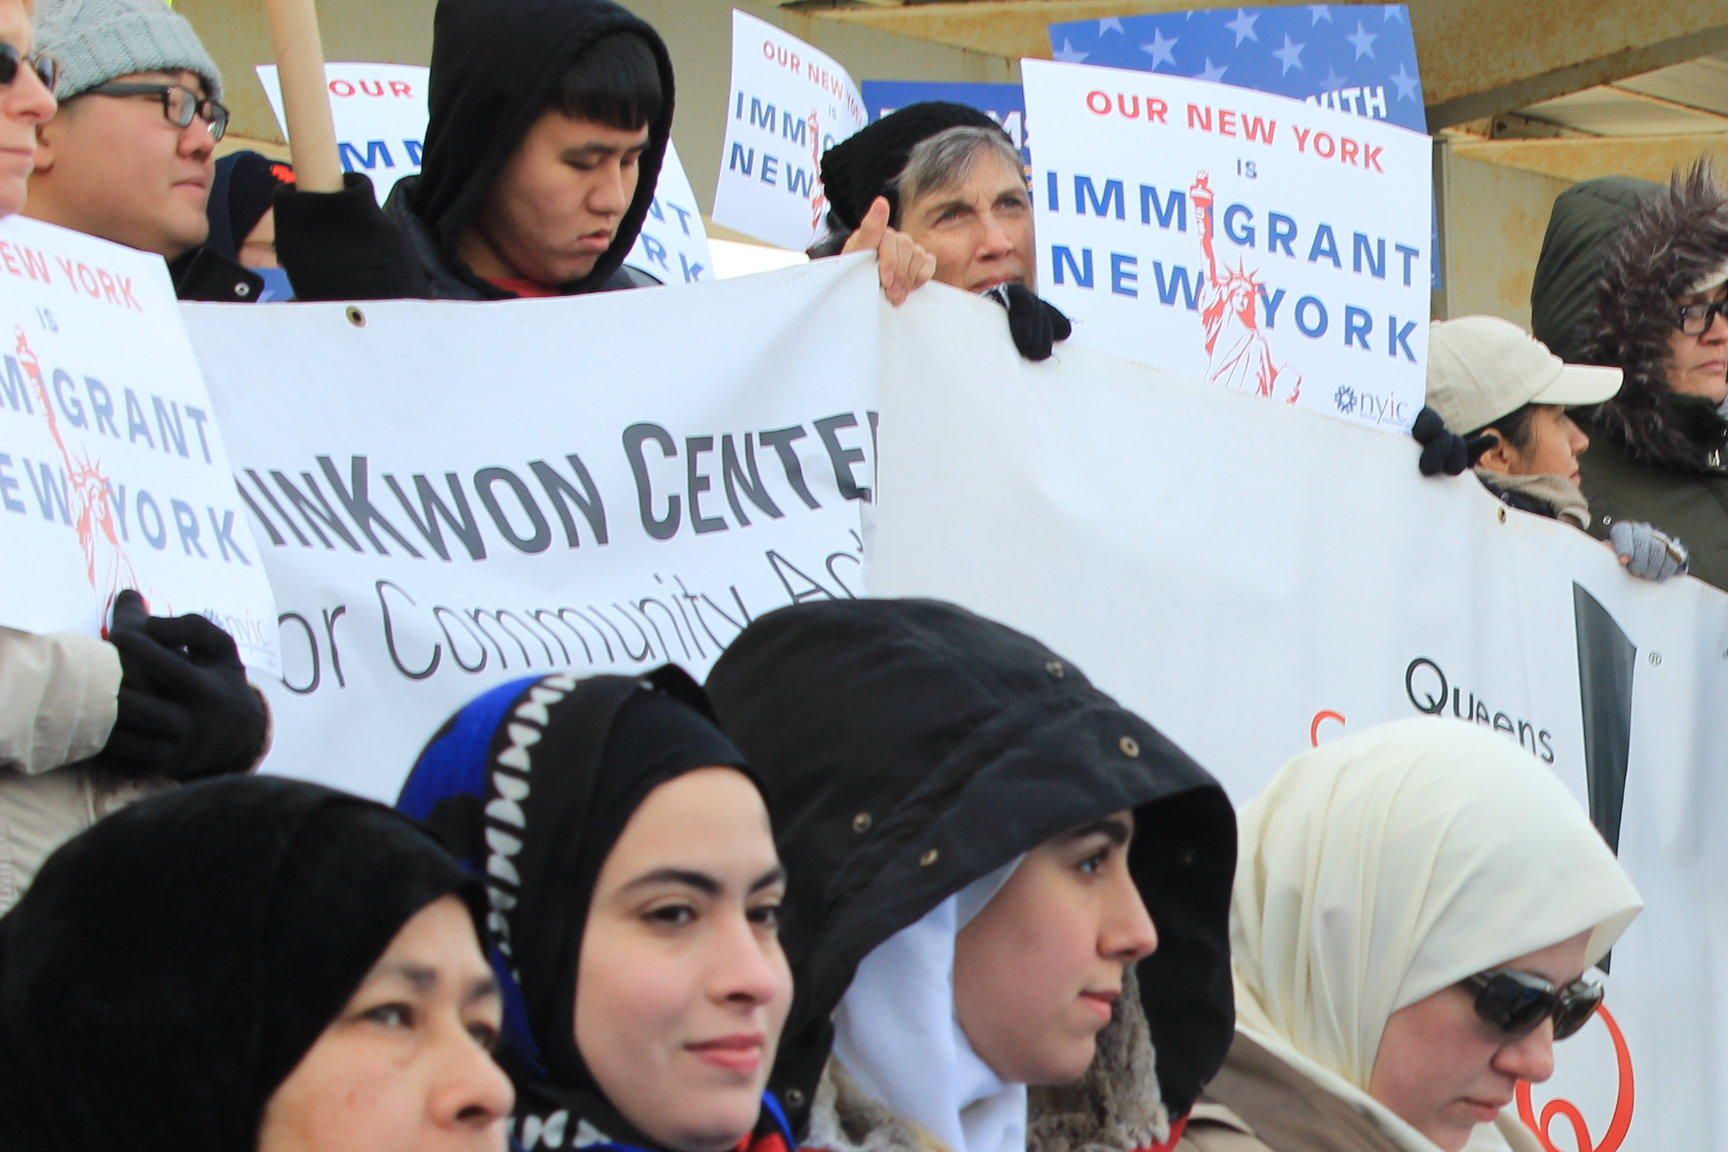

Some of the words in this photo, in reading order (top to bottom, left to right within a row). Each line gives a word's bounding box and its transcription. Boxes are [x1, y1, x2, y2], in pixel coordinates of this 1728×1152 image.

[328, 79, 414, 99] OUR
[761, 39, 801, 75] OUR
[807, 61, 844, 100] NEW
[1085, 89, 1168, 125] OUR
[1186, 102, 1277, 146] NEW
[1292, 124, 1385, 175] YORK
[1236, 157, 1259, 180] IS
[730, 140, 815, 201] NEW
[1045, 168, 1421, 289] IMMIGRANT
[0, 240, 51, 285] EW
[55, 254, 145, 315] YORK
[1050, 243, 1204, 315] NEW
[1258, 282, 1419, 366] YORK
[35, 304, 60, 334] IS
[1360, 391, 1410, 425] nyic
[621, 410, 880, 541] CENTE
[104, 483, 252, 567] YORK
[277, 604, 347, 697] or
